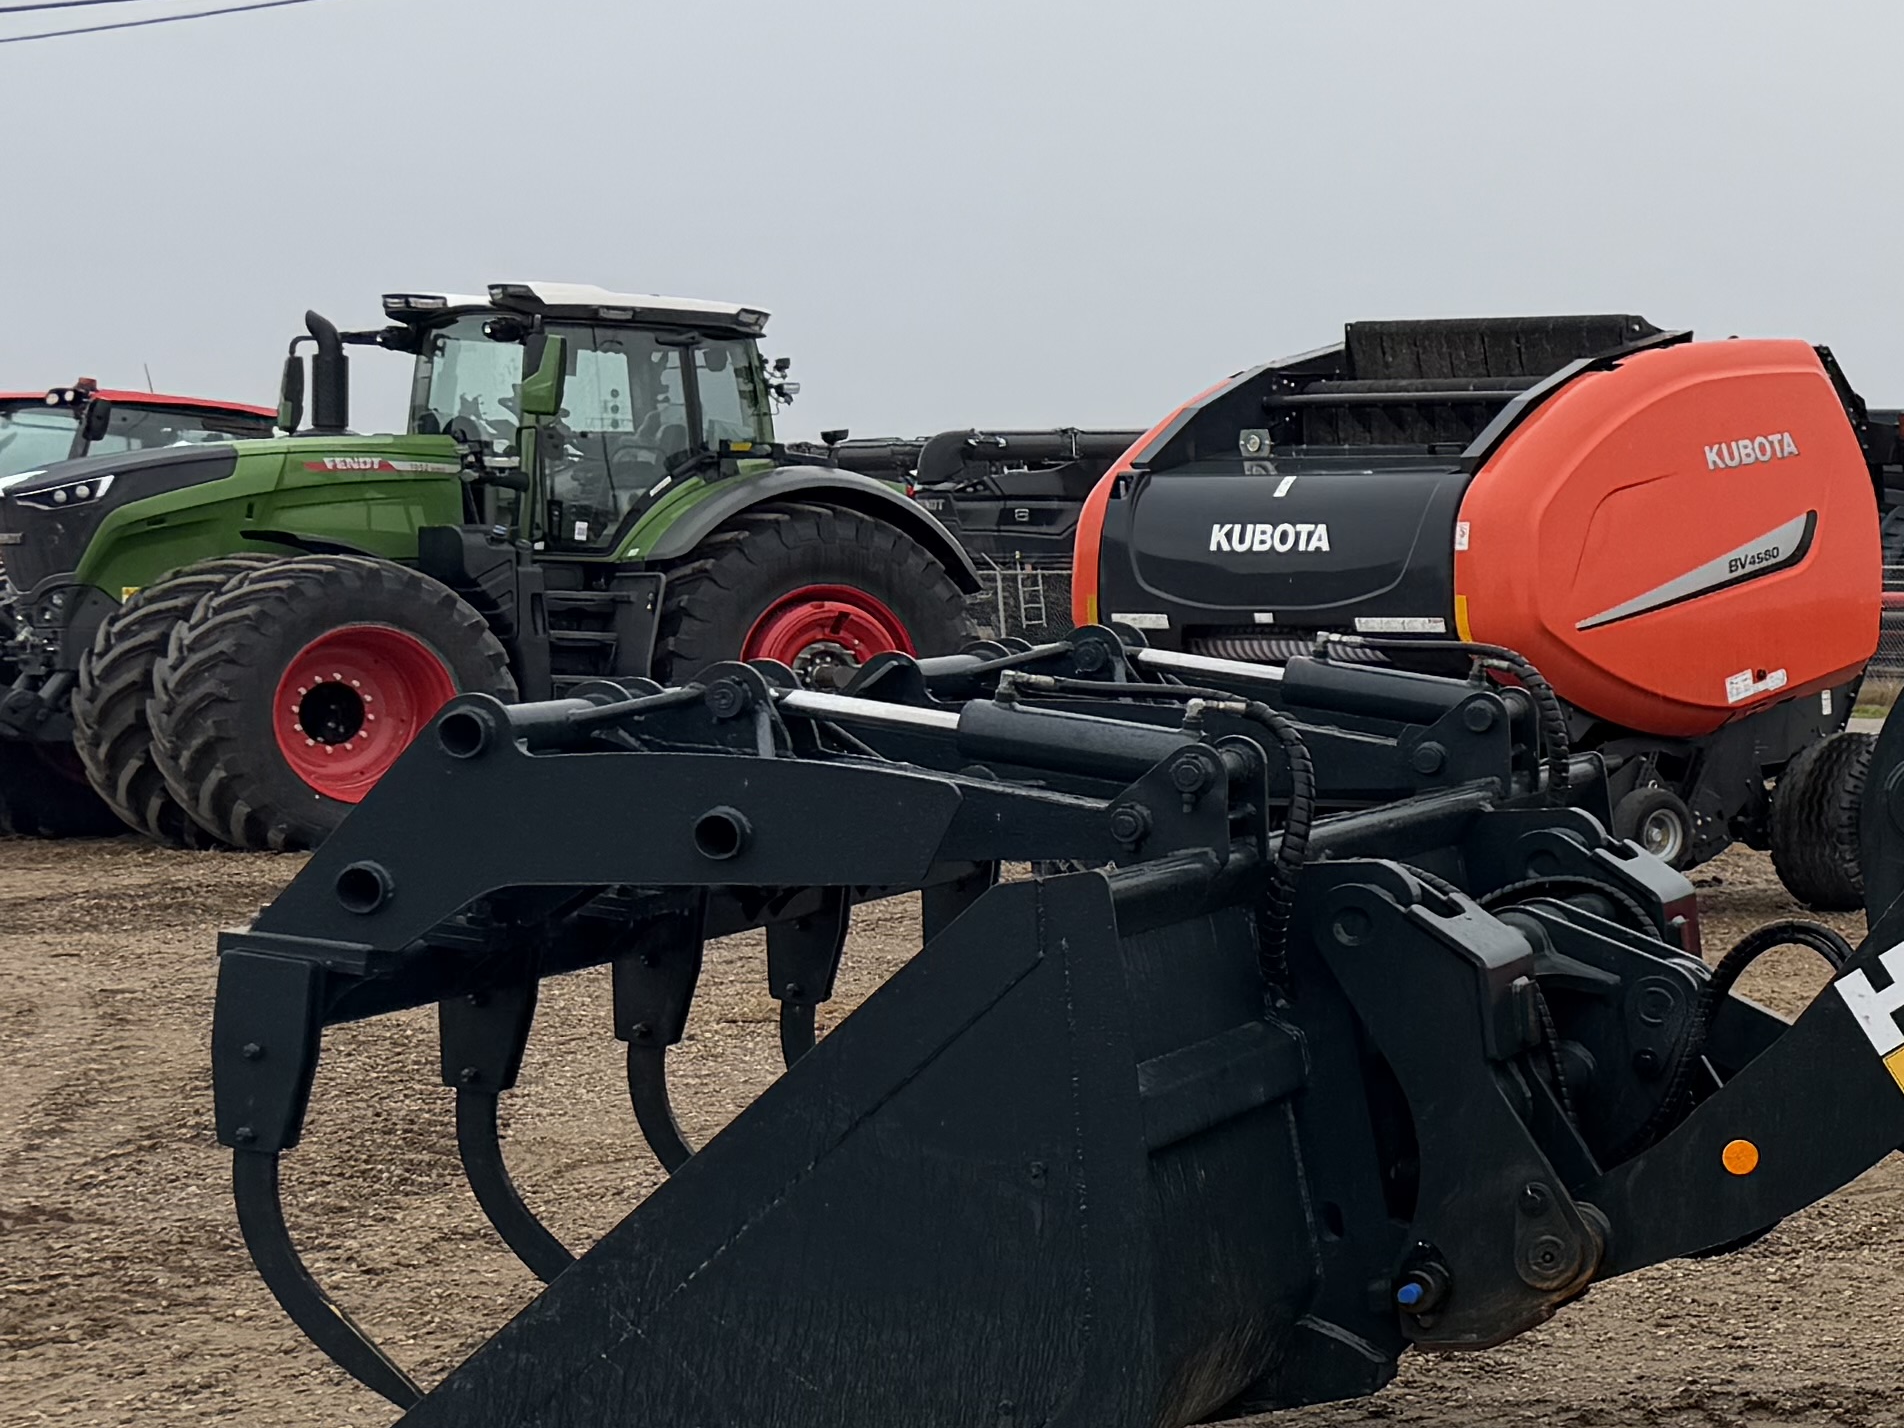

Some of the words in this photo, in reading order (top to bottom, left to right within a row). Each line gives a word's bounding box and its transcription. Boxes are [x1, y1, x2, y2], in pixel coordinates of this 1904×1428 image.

[322, 457, 382, 470] FENDT
[1704, 431, 1799, 470] KUBOTA
[1209, 522, 1331, 553] KUBOTA
[1728, 545, 1780, 574] BV4580
